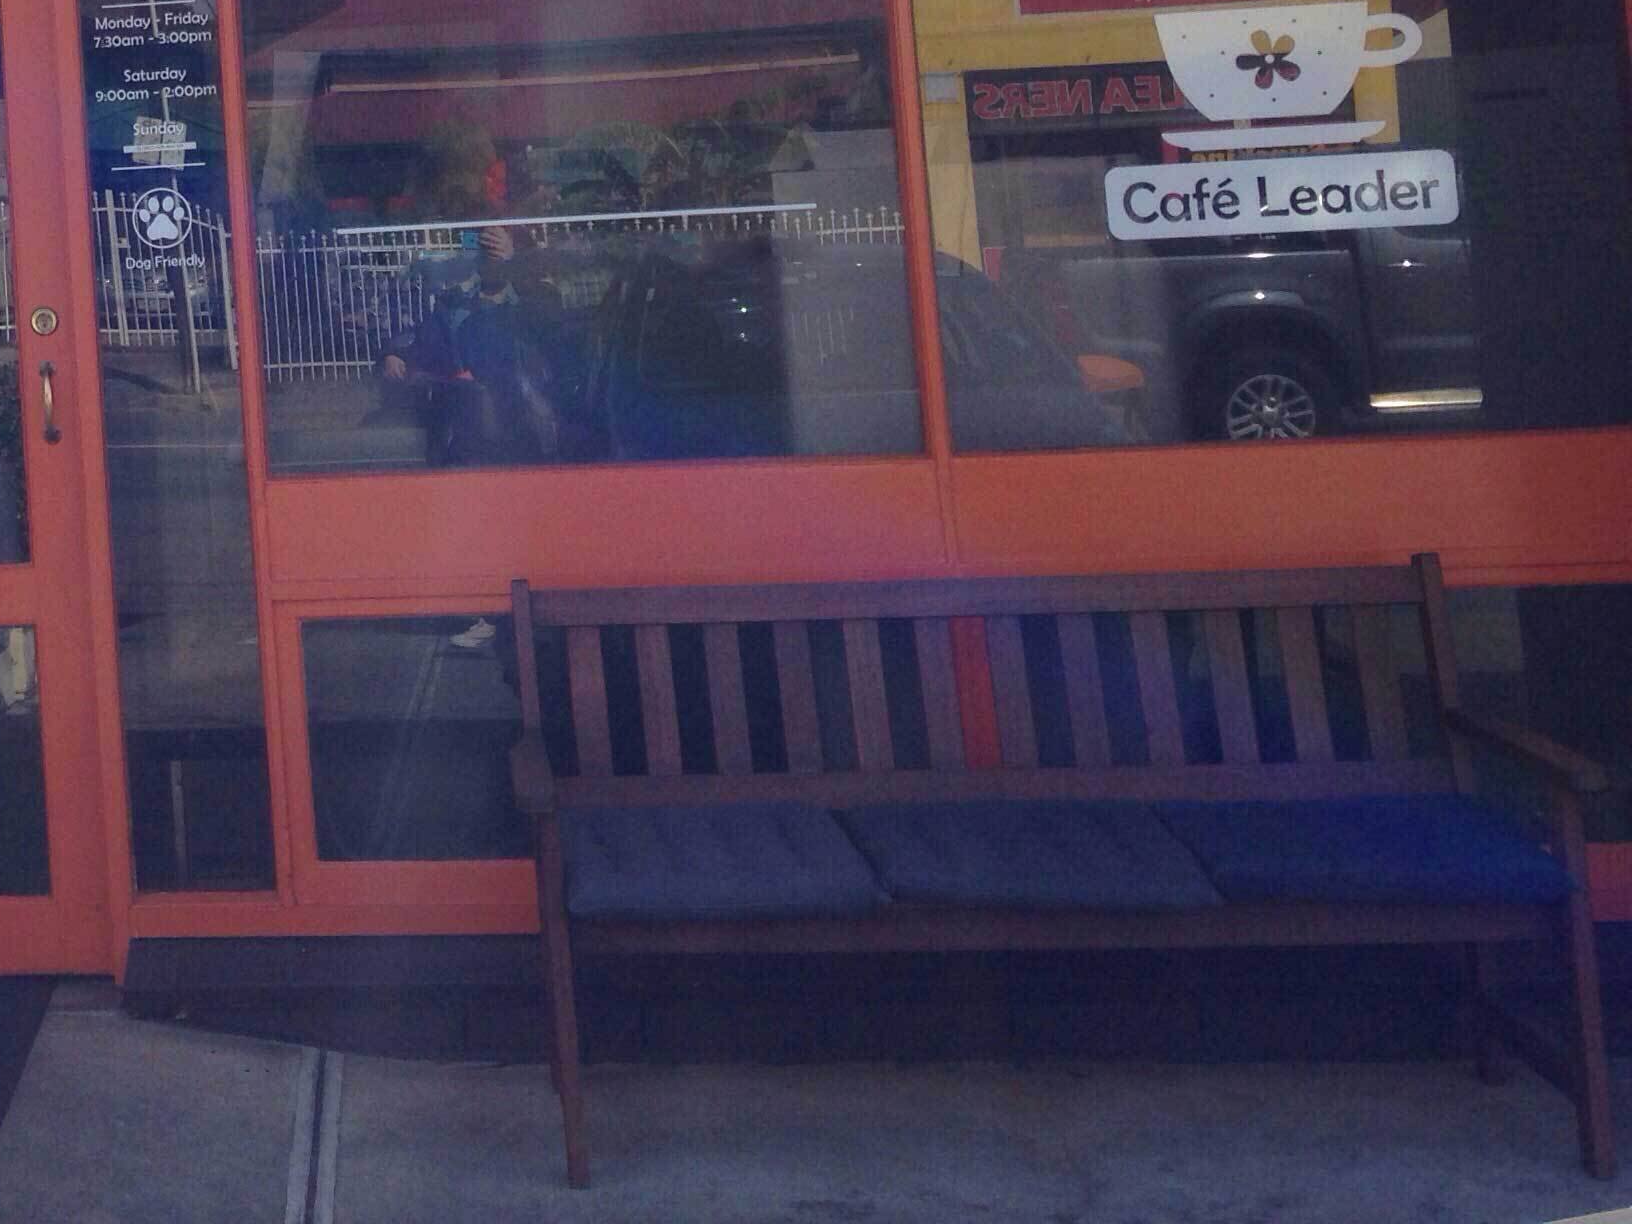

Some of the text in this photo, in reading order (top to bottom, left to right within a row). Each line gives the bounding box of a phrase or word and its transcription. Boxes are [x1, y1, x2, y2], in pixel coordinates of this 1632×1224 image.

[95, 16, 151, 30] Monday
[164, 12, 209, 26] Friday
[93, 35, 145, 49] 7:30am
[158, 31, 212, 45] 3:00pm
[123, 67, 187, 83] Saturday
[95, 89, 150, 103] 9:00am
[164, 84, 217, 99] 2:00pm
[133, 120, 184, 136] Sunday
[1123, 169, 1441, 224] Café Leader
[125, 253, 206, 270] Dog Friendly
